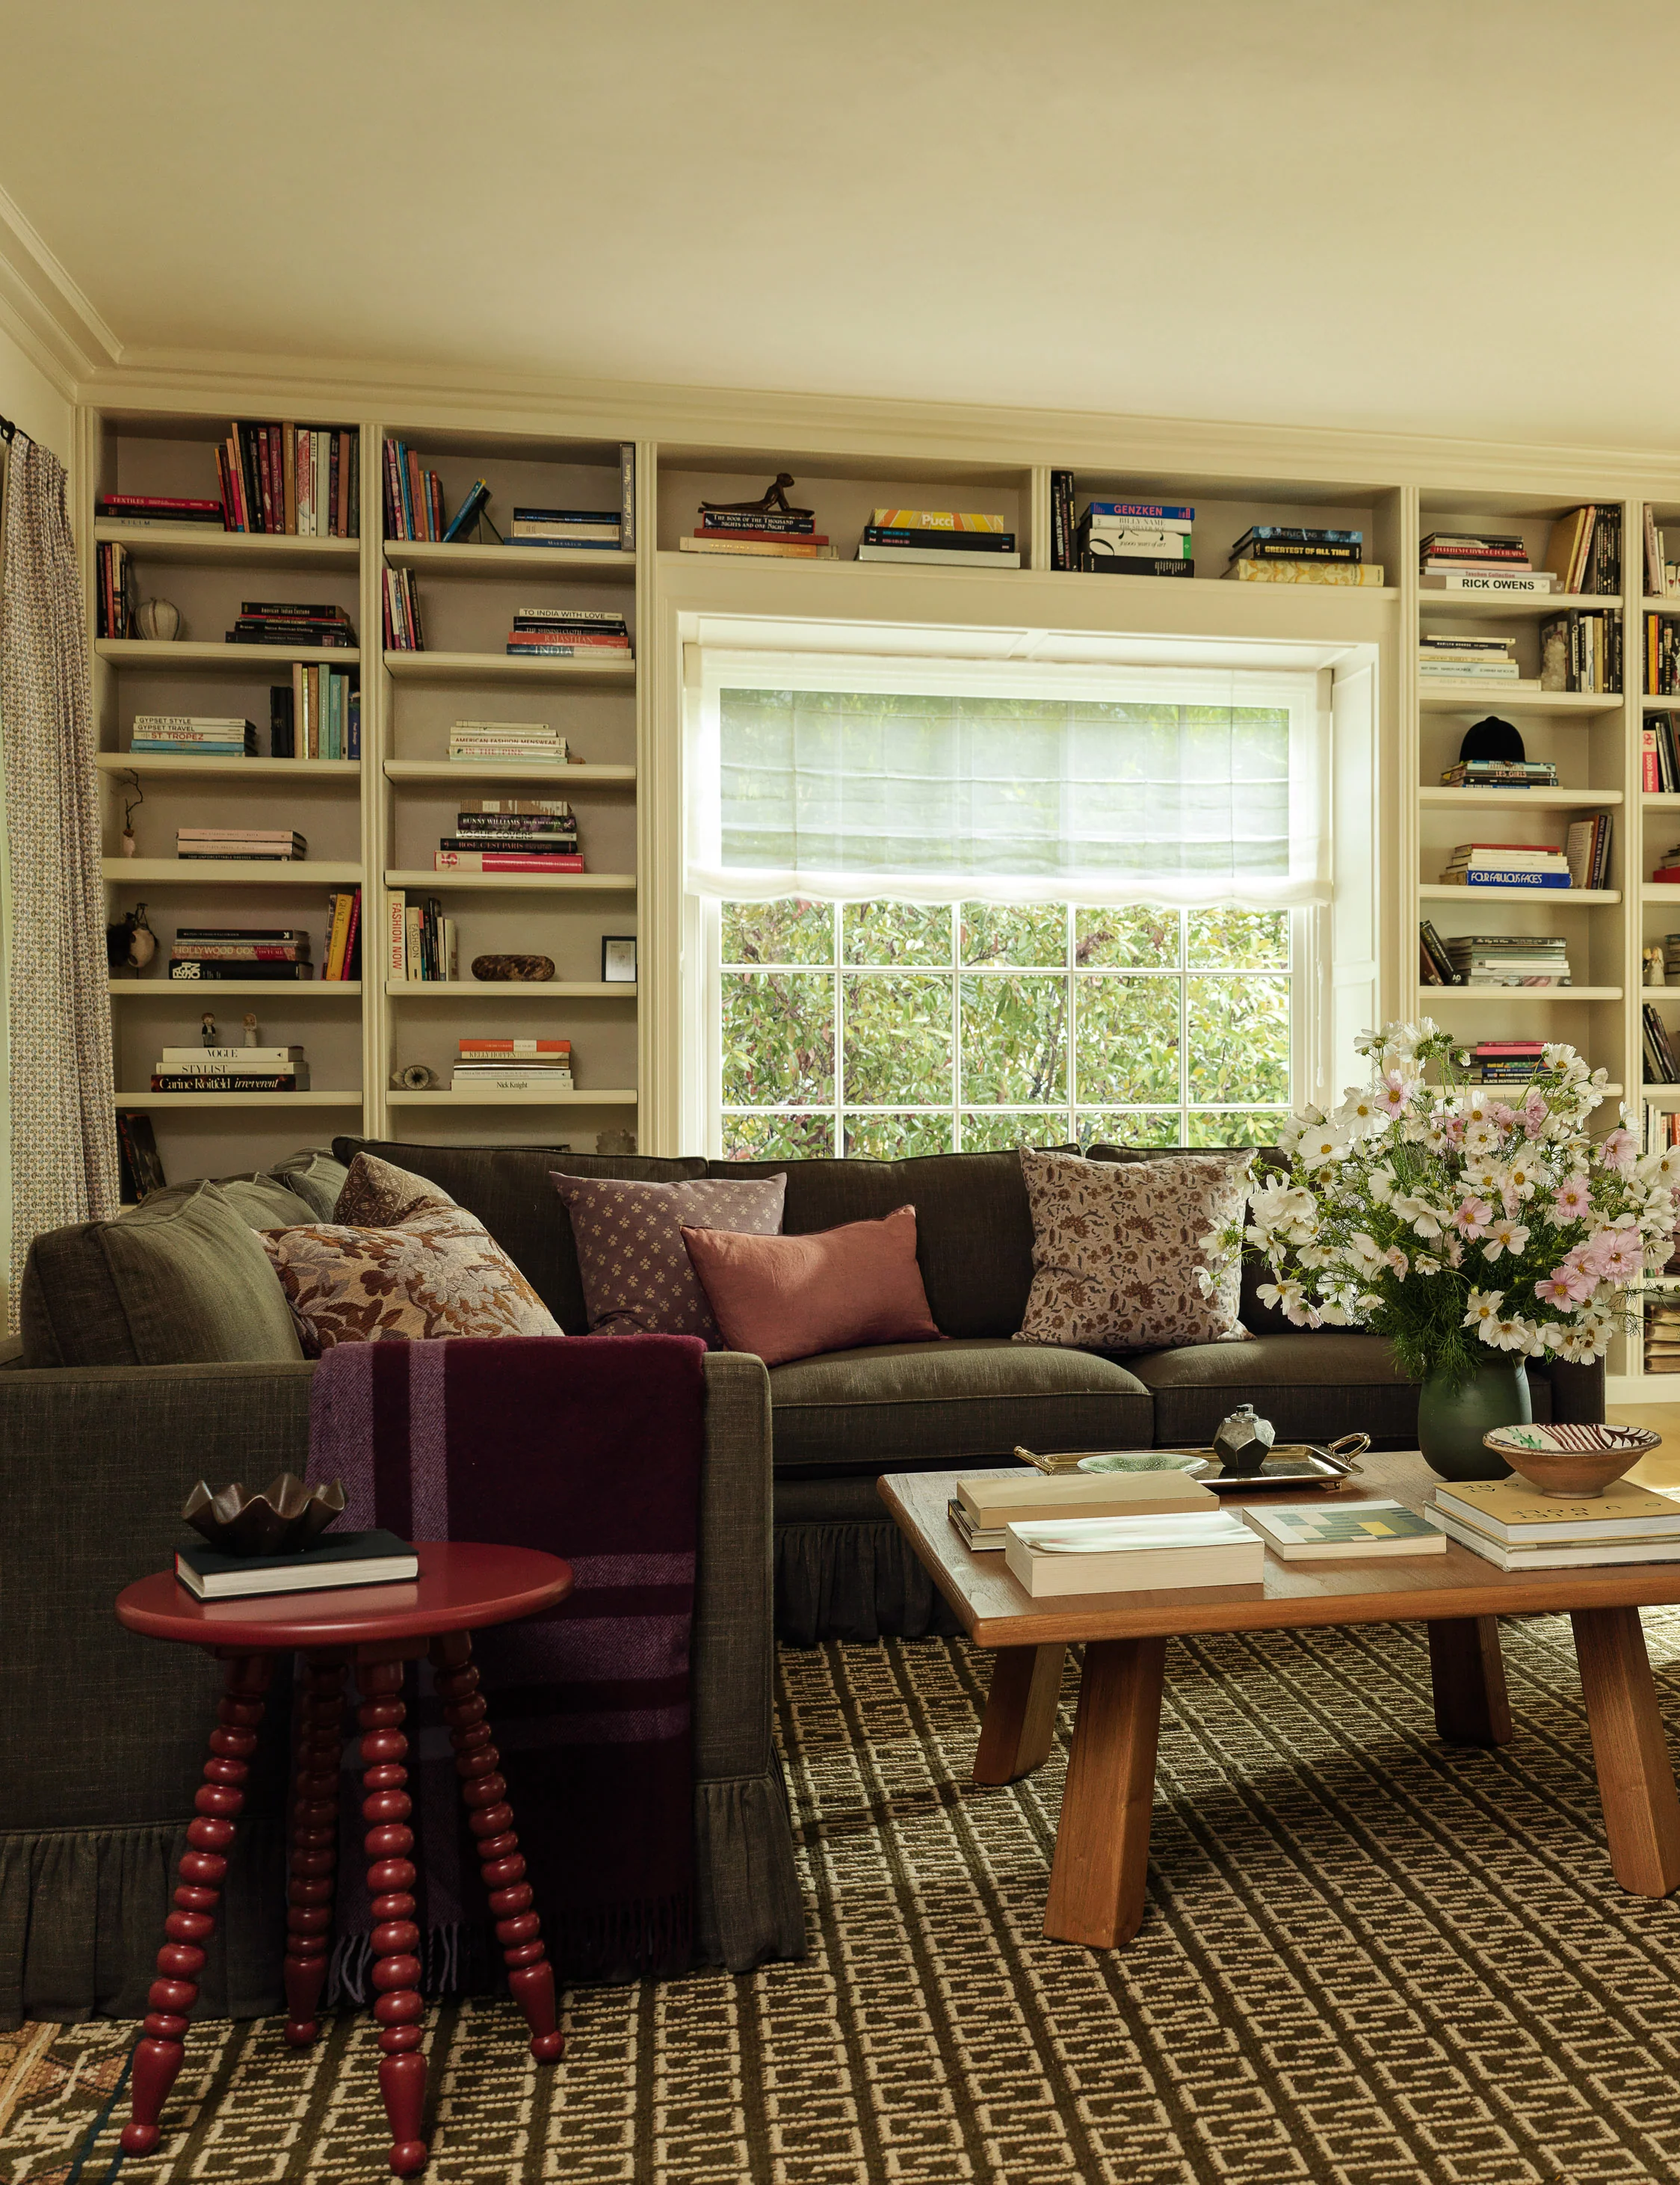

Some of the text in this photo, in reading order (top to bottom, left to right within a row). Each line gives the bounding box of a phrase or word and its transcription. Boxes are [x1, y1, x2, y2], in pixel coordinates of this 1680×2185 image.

[112, 496, 145, 505] TEXTILES
[1114, 504, 1163, 517] GENZKEN
[765, 517, 794, 525] THOUSAND
[921, 514, 954, 527] Pucci
[1119, 517, 1140, 526] BILLY
[768, 523, 785, 531] NIGHT
[1264, 546, 1304, 554] GREATEST
[1462, 579, 1534, 590] RICK OWENS
[544, 635, 593, 644] RAJASTHAN
[534, 646, 573, 655] INDIA
[495, 831, 533, 839] COVERS
[1471, 872, 1542, 884] FOUR FABULOUS FACES
[392, 902, 402, 970] FASHION NOW
[411, 923, 419, 958] FASHION
[174, 946, 233, 955] HOLLYWOOD
[207, 1049, 238, 1058] VOGUE
[182, 1064, 228, 1073] STYLIST
[159, 1078, 279, 1089] Carine Roitfeld irreverent
[510, 1082, 528, 1090] Knight
